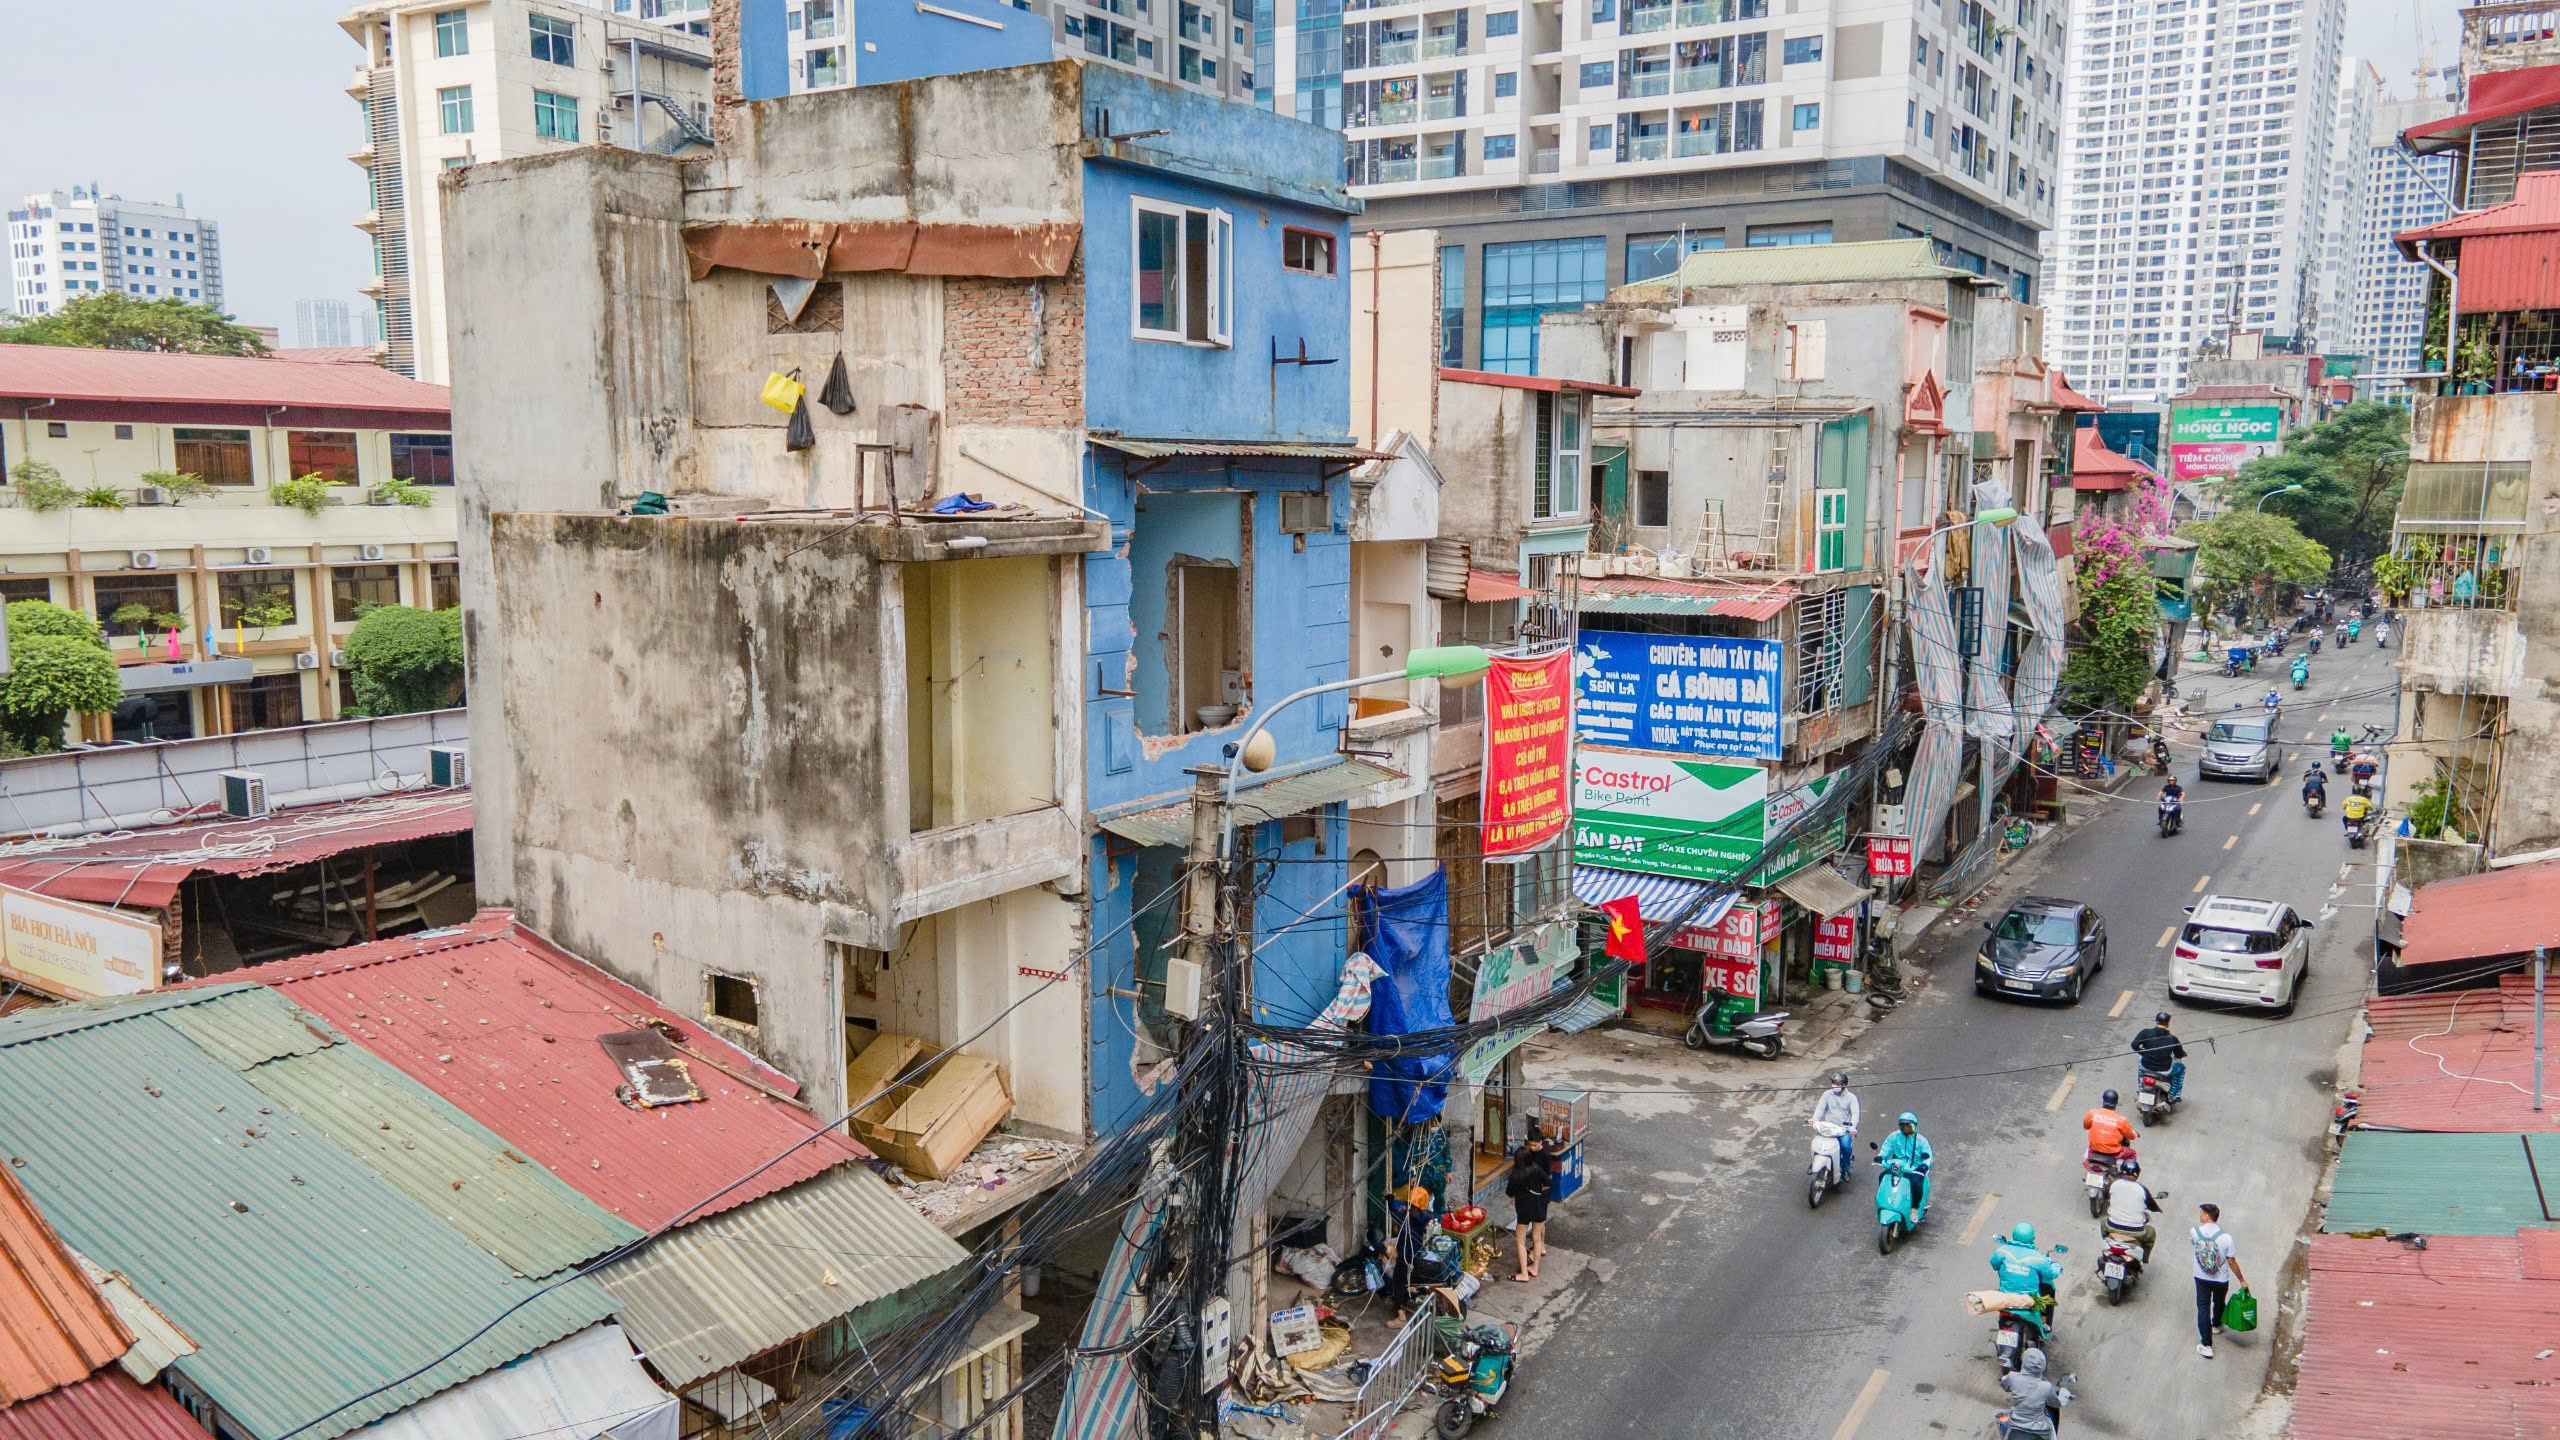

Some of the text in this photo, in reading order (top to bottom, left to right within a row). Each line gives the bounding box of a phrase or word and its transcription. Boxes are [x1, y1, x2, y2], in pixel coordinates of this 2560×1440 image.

[2178, 420, 2223, 434] HỒNG
[2226, 421, 2272, 436] NGỌC
[1650, 642, 1778, 671] CHUYÊN: MÓN TÂY BẮC
[1589, 679, 1636, 696] SƠN LA
[1656, 670, 1770, 705] CÁ SÔNG ĐÀ
[1649, 701, 1673, 720] CÁC
[1675, 703, 1703, 722] MÓN
[1706, 704, 1723, 724] ĂN
[1725, 708, 1742, 728] TỰ
[1743, 710, 1777, 731] CHỌN
[1651, 724, 1680, 746] NHẬN:
[1693, 739, 1761, 753] Phục vụ tại nhà
[1585, 766, 1671, 793] Castrol
[1585, 788, 1651, 807] Bike Point
[1778, 796, 1805, 820] Castrol
[1574, 826, 1646, 856] ẤN ĐẠT
[1657, 841, 1751, 863] SỬA XE CHUYÊN NGHIỆP
[1870, 838, 1890, 853] THAY
[1875, 853, 1906, 873] RỬA XE
[1725, 911, 1754, 938] SỐ
[1837, 924, 1848, 938] XE
[1686, 933, 1719, 951] THAY
[1836, 942, 1851, 959] PHÍ
[1705, 965, 1758, 995] XE SỐ
